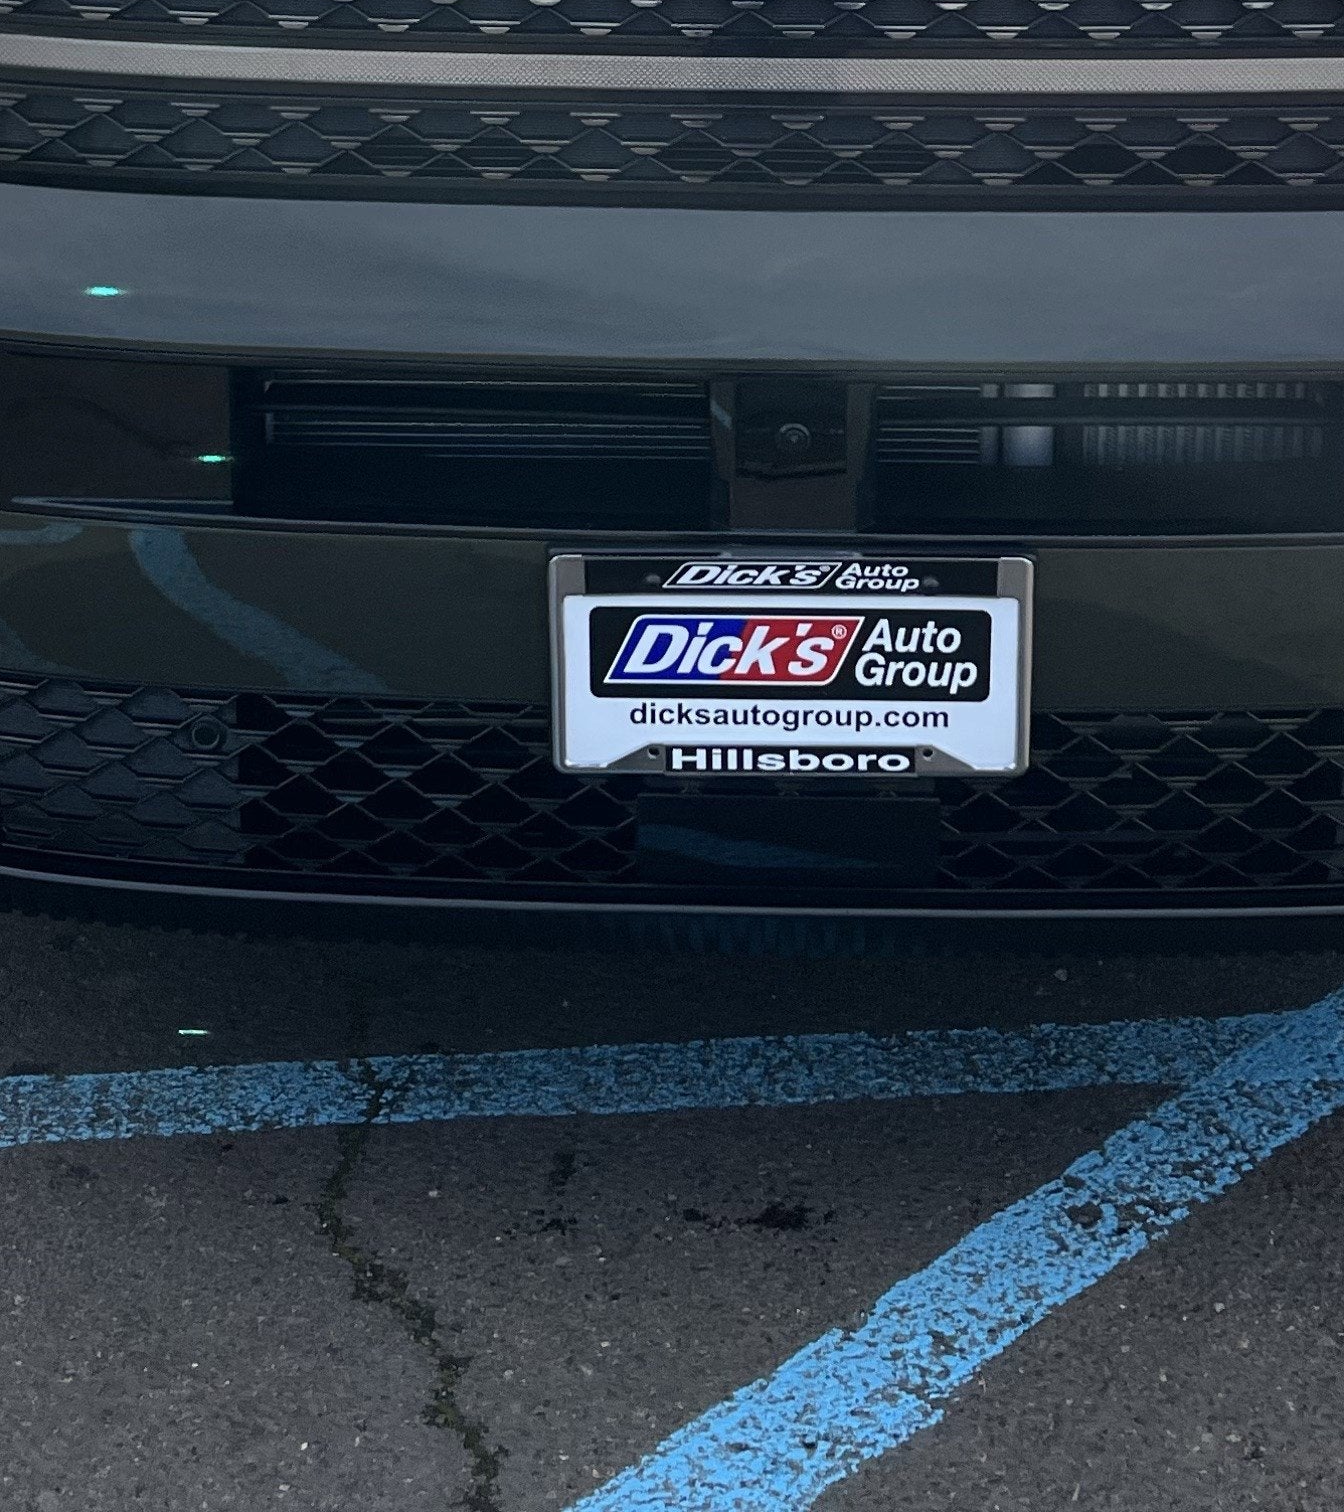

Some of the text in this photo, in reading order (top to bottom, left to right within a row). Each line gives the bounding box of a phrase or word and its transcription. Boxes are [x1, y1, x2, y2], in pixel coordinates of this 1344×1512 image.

[835, 575, 919, 592] Group
[840, 563, 909, 578] Auto
[862, 619, 961, 654] Auto
[855, 654, 978, 695] Group
[630, 702, 949, 732] dicksautogroup.com
[672, 748, 910, 772] Hillsboro
